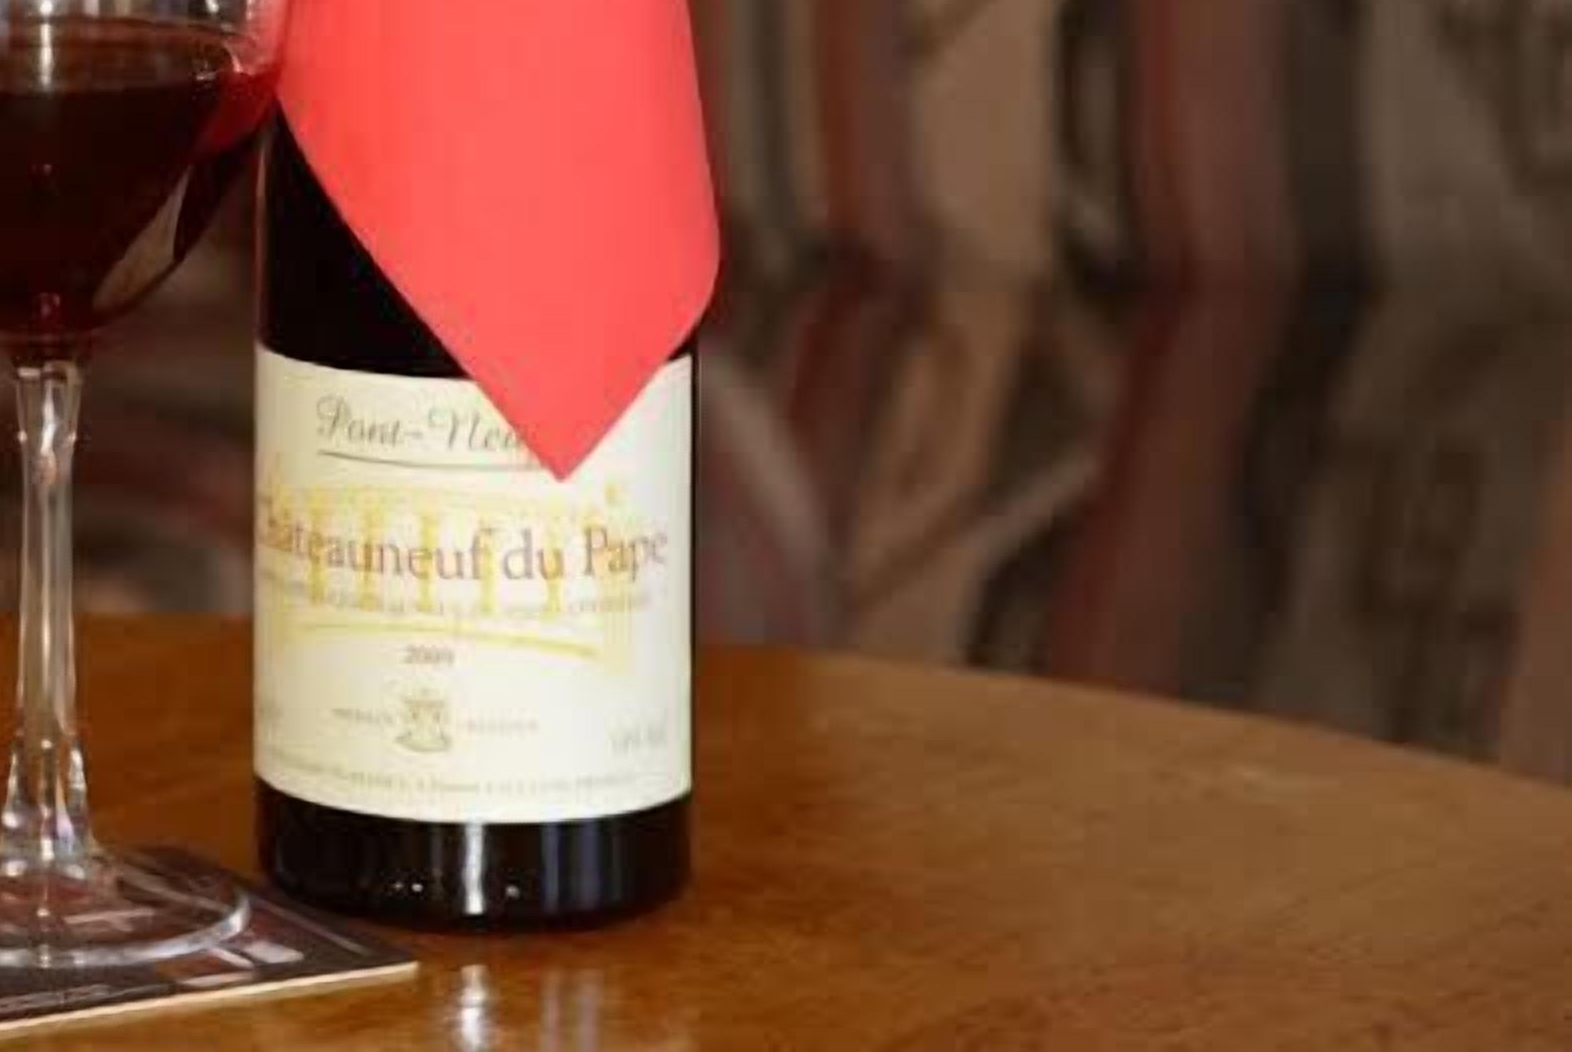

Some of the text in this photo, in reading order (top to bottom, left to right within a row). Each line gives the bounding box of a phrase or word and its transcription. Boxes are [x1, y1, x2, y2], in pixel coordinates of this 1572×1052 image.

[315, 396, 525, 451] Pont-Neu
[503, 527, 564, 580] du
[583, 525, 668, 582] Pape
